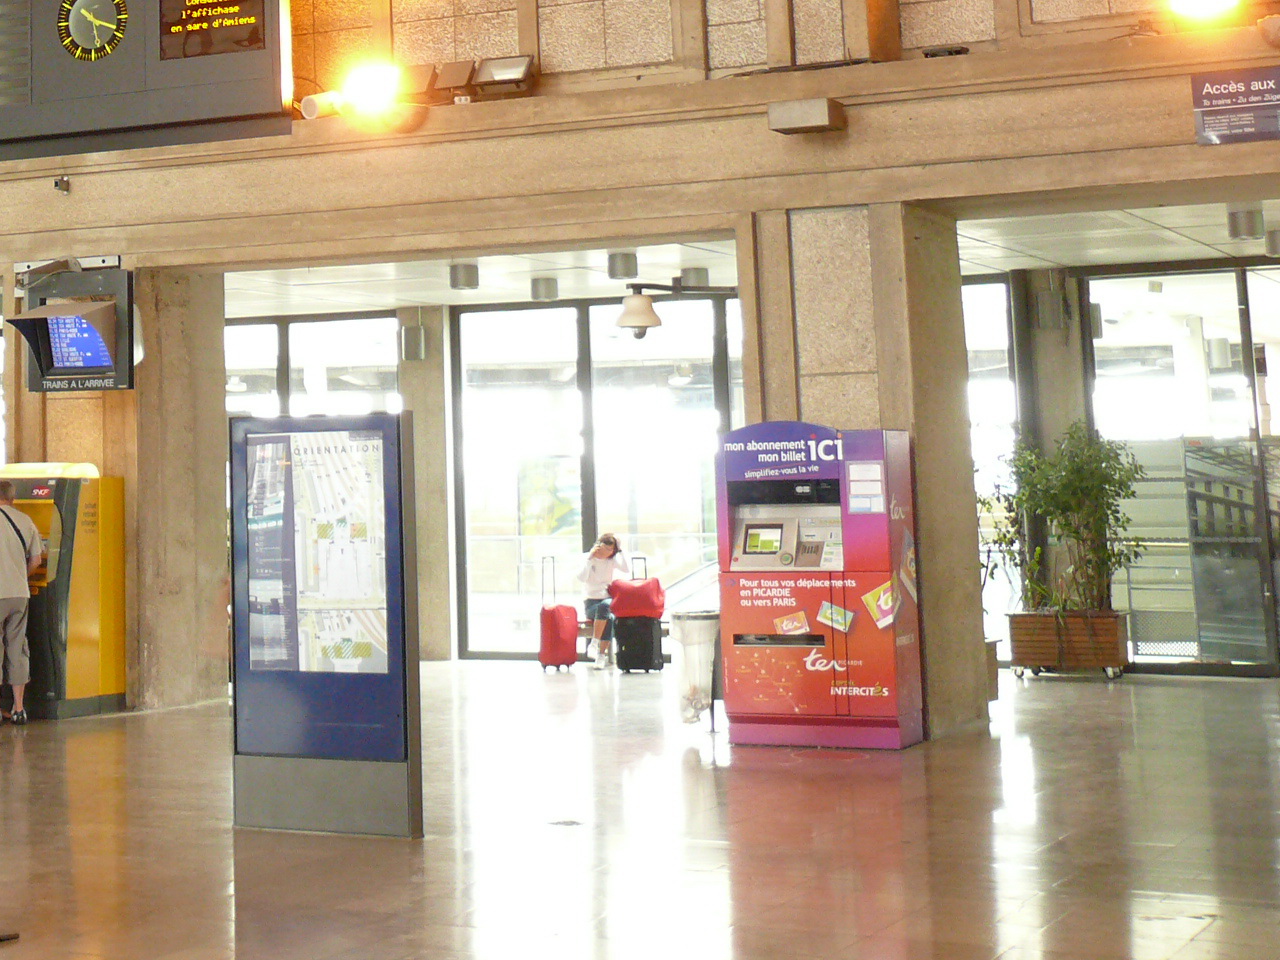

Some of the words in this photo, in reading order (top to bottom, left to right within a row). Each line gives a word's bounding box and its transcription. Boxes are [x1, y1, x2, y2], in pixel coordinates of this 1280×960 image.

[212, 16, 256, 28] d'Amiens
[1202, 80, 1245, 95] Accès
[1250, 79, 1276, 90] aux
[42, 381, 69, 389] TRAINS
[293, 444, 379, 456] ORIENTATION
[724, 442, 744, 451] mon
[747, 440, 806, 451] abonnement
[758, 453, 779, 462] mon
[781, 451, 806, 462] billet
[745, 467, 797, 479] simplifiez-vous
[799, 465, 806, 473] la
[808, 464, 819, 472] vie
[32, 488, 50, 496] SNCF
[740, 578, 758, 587] Pour
[761, 578, 779, 587] tous
[797, 577, 856, 588] déplacements
[753, 587, 790, 597] PICARDIE
[753, 599, 771, 607] vers
[773, 598, 796, 606] PARIS
[803, 648, 847, 671] ter
